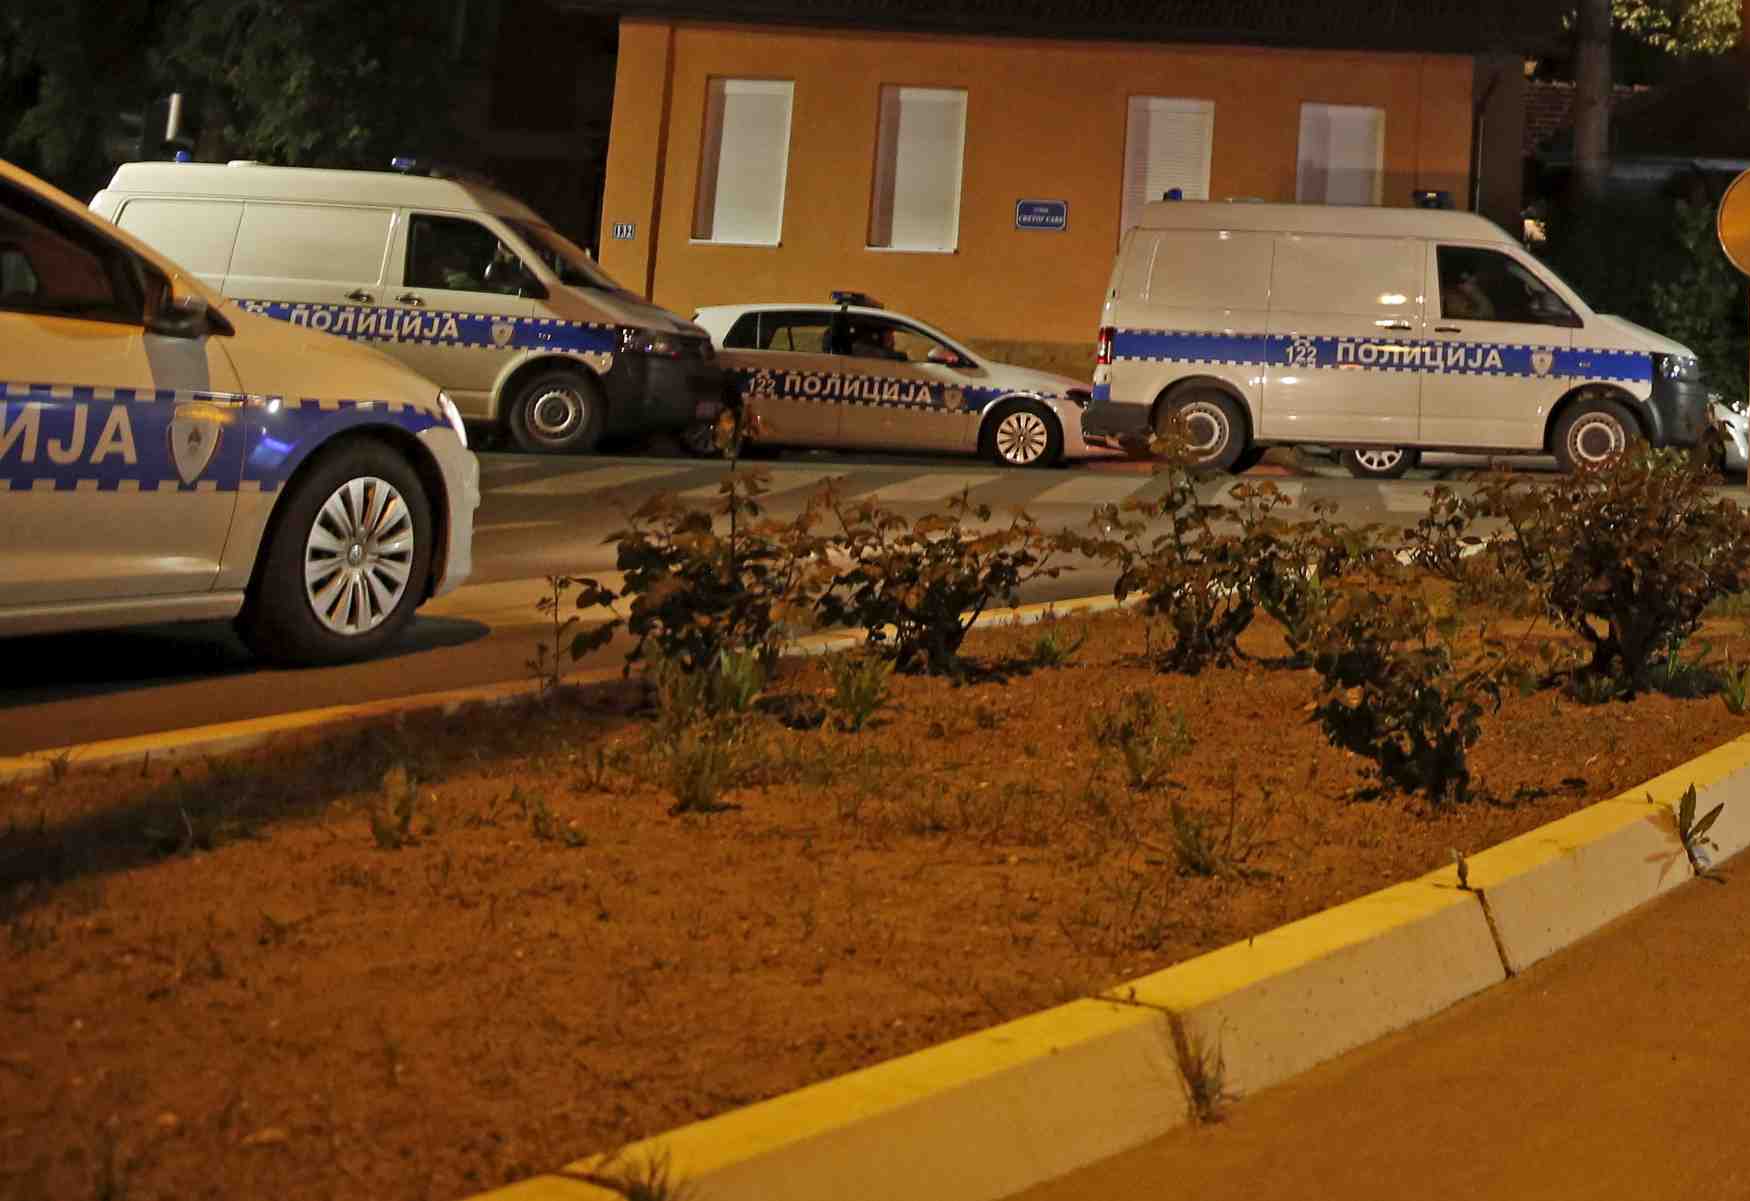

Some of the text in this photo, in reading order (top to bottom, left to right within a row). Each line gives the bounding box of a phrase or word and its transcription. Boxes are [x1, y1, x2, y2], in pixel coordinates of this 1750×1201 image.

[1285, 342, 1503, 368] 122 ПОЛИЦИЈА
[784, 374, 932, 403] ПОЛИЦИЈА
